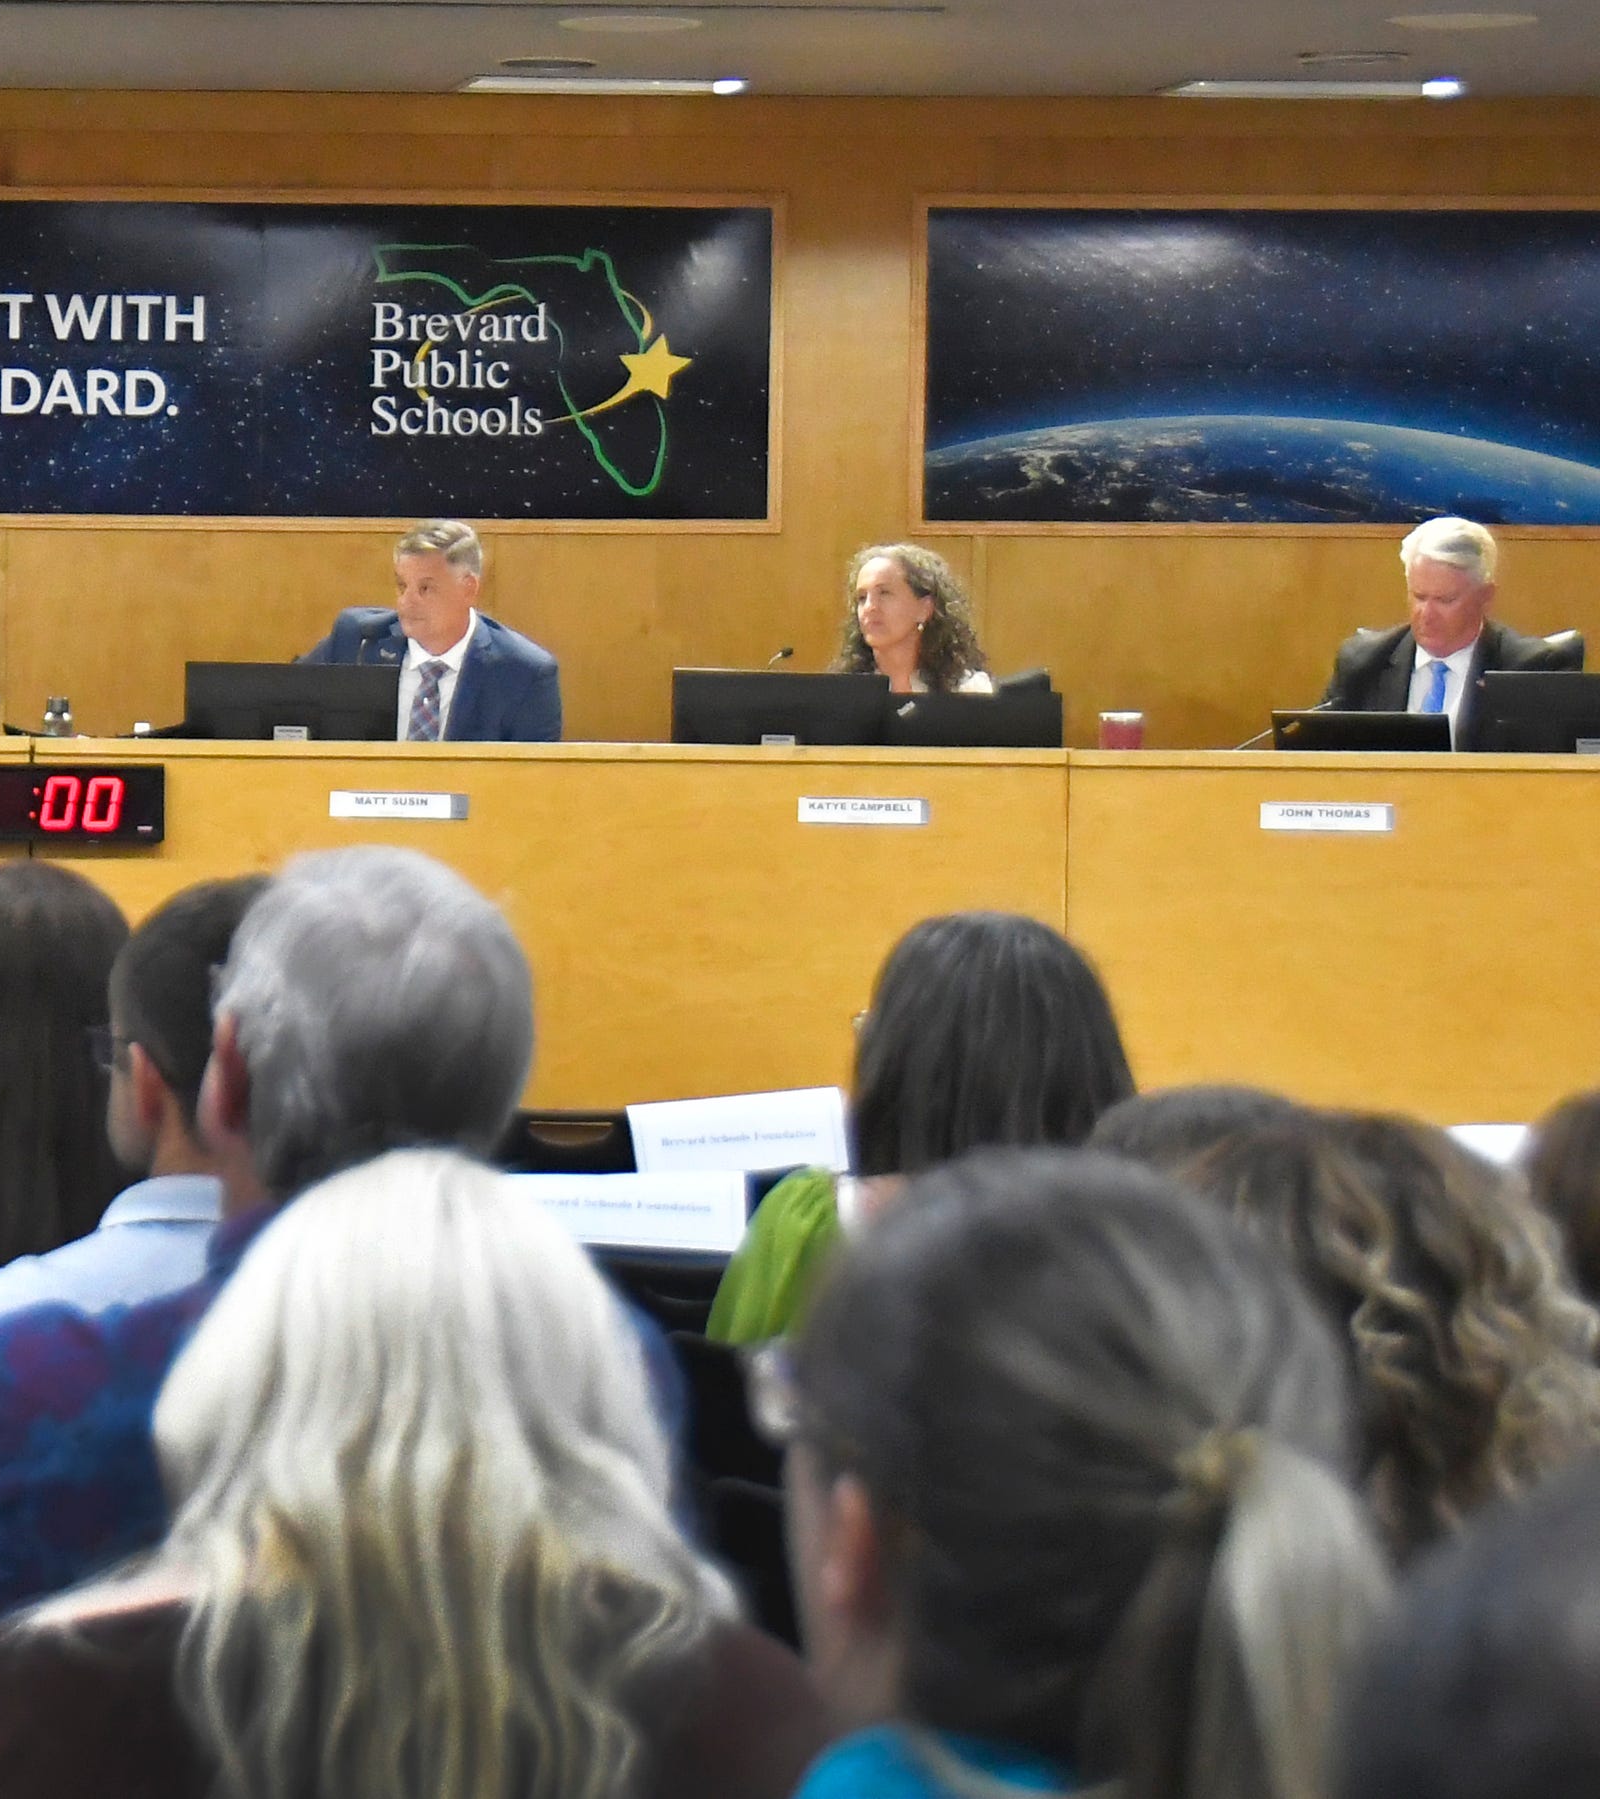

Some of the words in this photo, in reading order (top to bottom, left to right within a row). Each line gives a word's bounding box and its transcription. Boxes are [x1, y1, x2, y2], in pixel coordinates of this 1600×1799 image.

[44, 293, 206, 342] WITH
[370, 301, 549, 342] Brevard
[369, 349, 511, 390] Public
[370, 395, 544, 436] Schools
[354, 796, 387, 805] MATT
[391, 797, 429, 806] SUSIN
[808, 801, 847, 810] KATYE
[851, 802, 913, 812] CAMPBELL
[1278, 808, 1313, 817] JOHN
[1318, 808, 1371, 818] THOMAS
